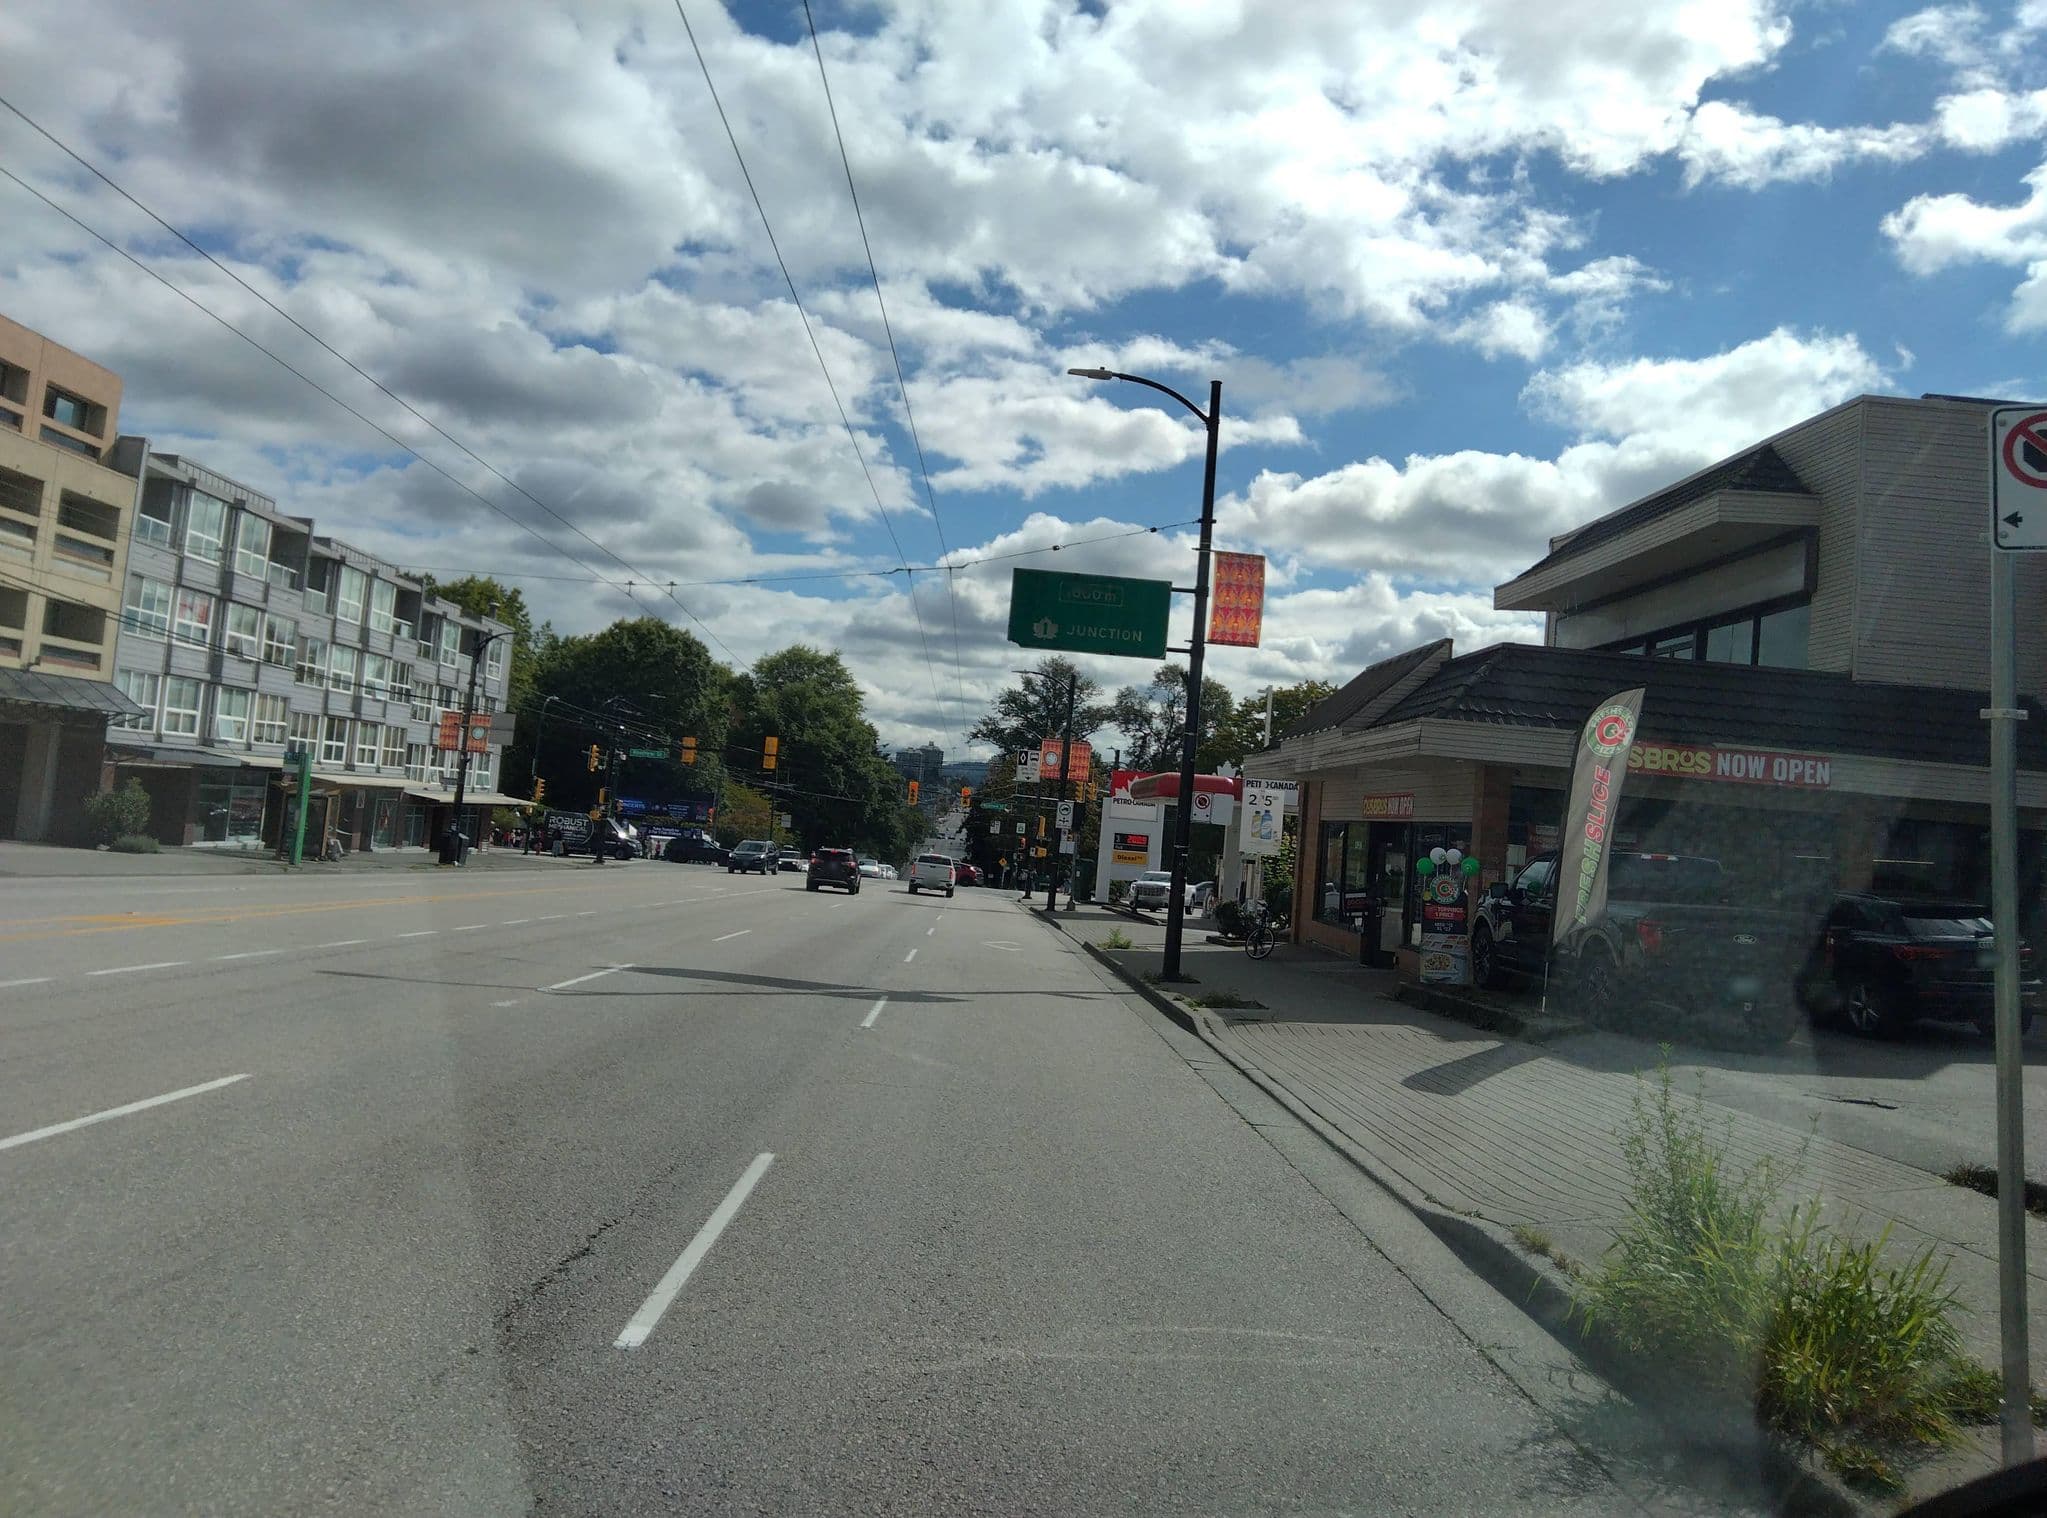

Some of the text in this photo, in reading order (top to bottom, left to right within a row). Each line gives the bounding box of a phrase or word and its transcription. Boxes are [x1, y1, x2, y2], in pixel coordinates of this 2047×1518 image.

[1066, 625, 1143, 642] JUNCTION
[1716, 752, 1765, 779] NOW
[1772, 757, 1830, 785] OPEN
[1246, 779, 1298, 791] PET-CANADA
[549, 815, 589, 827] ROBUST
